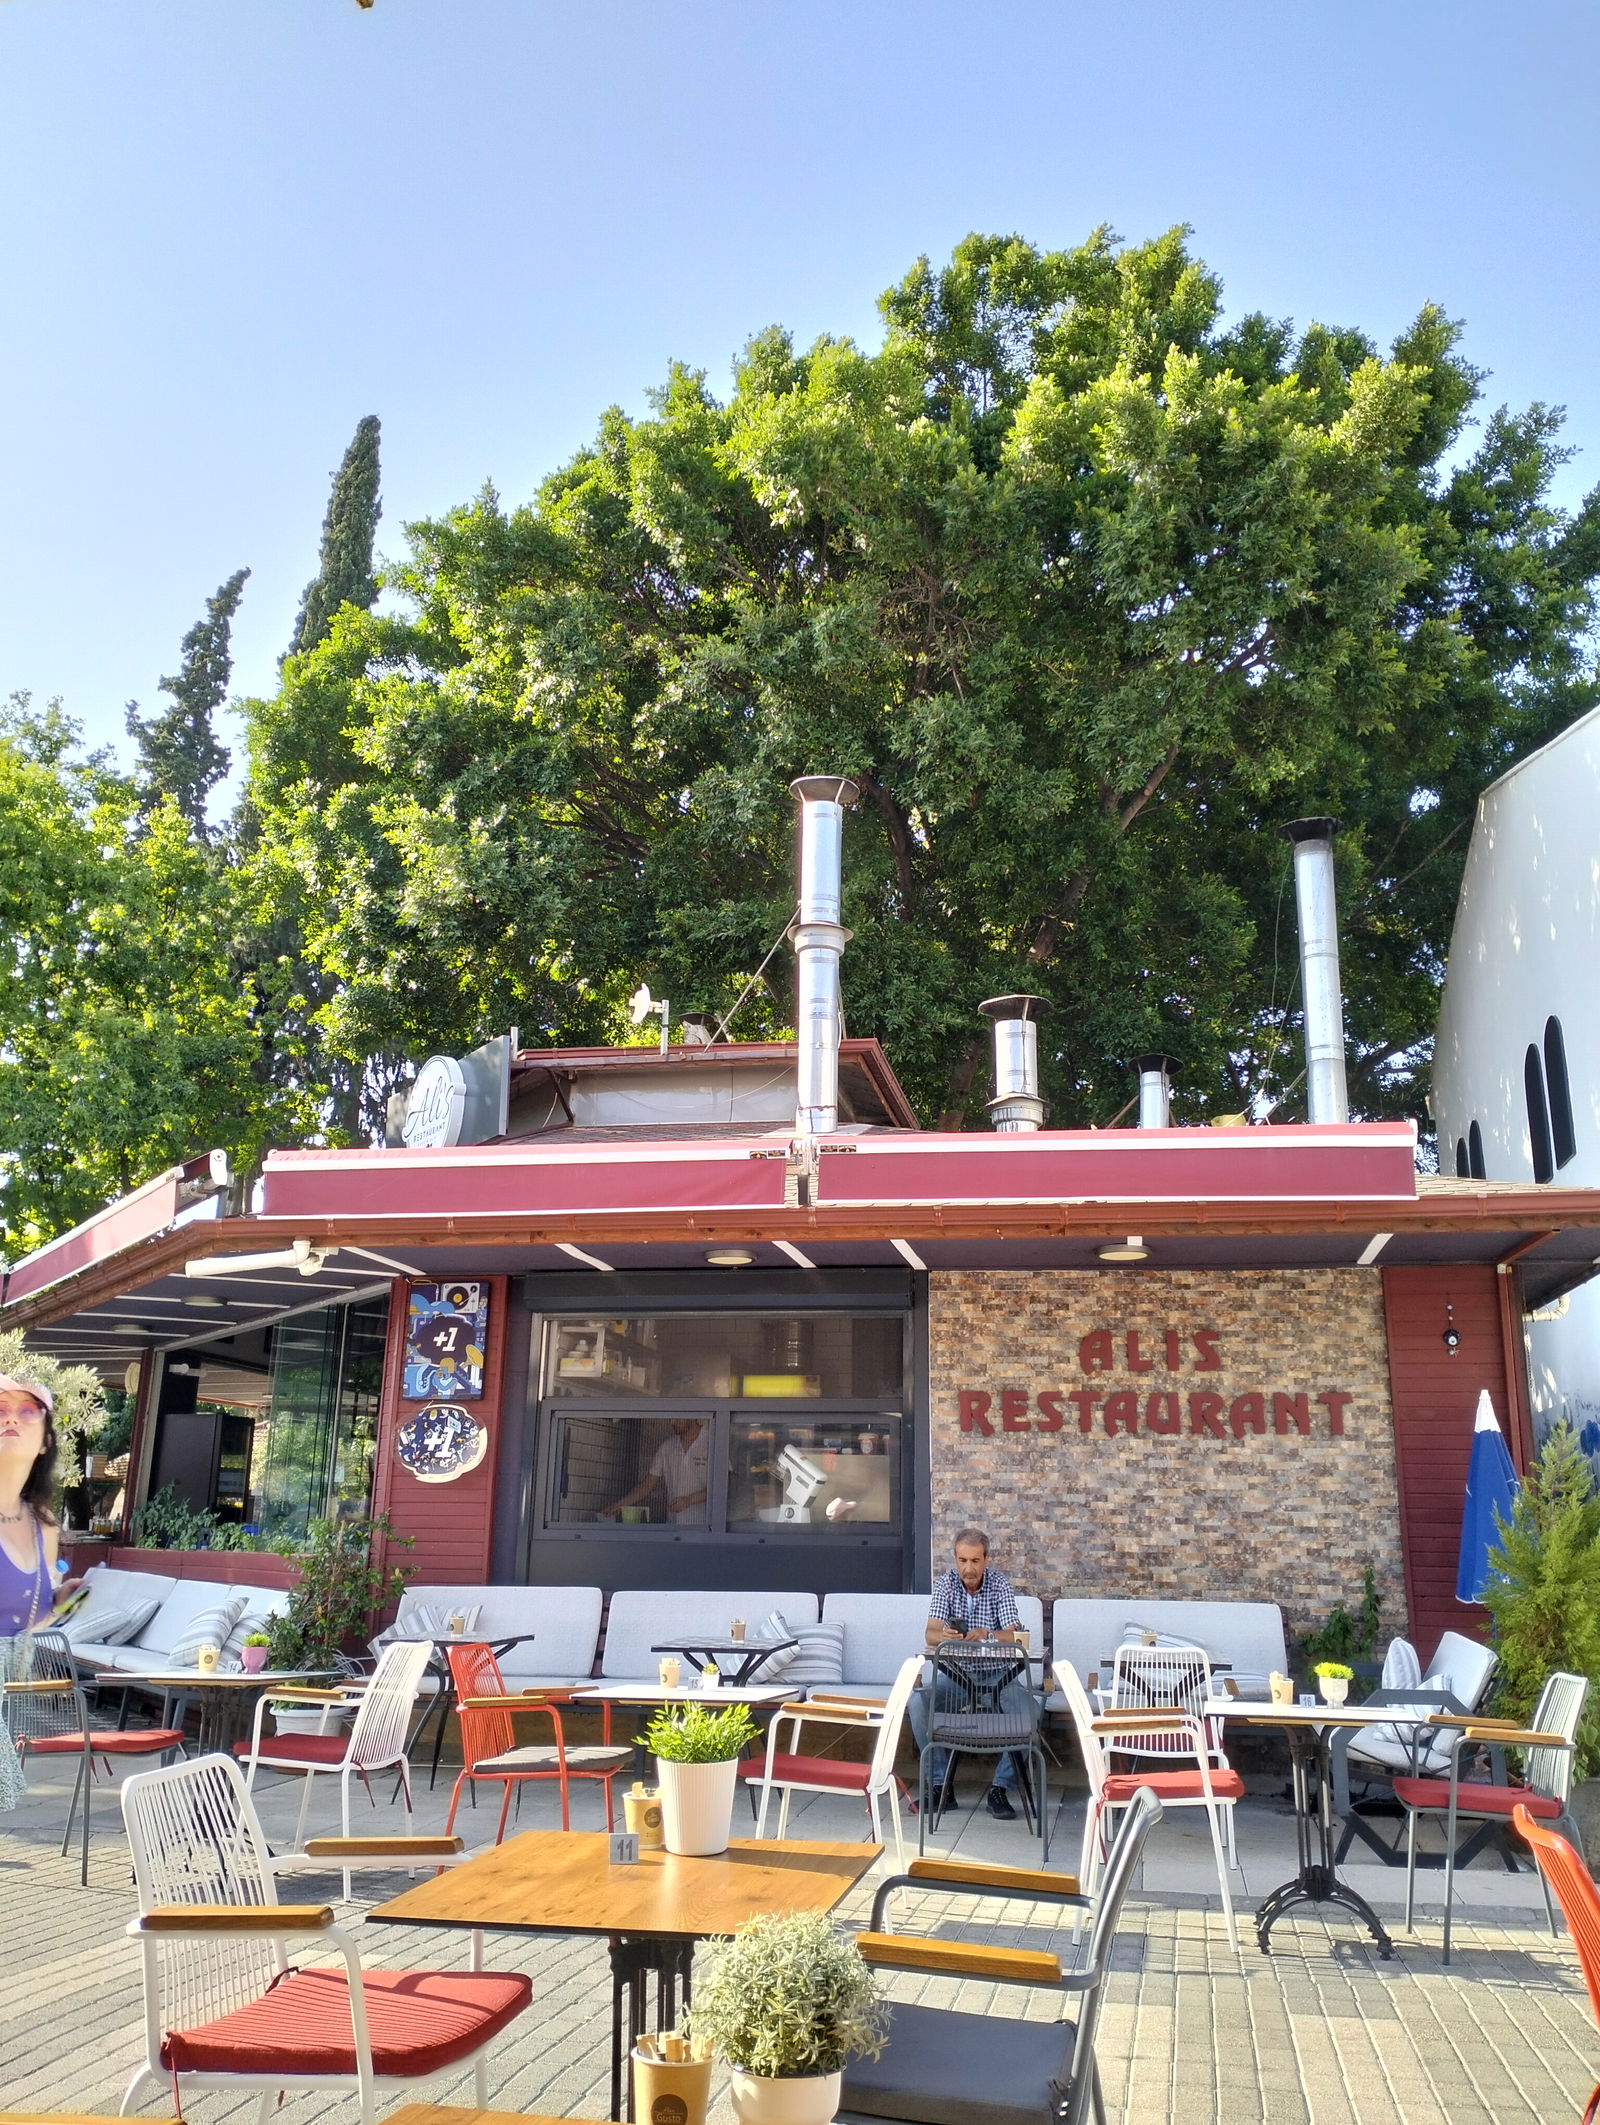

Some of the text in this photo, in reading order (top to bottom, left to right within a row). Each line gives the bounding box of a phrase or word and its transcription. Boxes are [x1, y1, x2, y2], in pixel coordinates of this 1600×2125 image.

[413, 1121, 447, 1143] RESTAURANT
[433, 1327, 458, 1352] +1
[1079, 1329, 1222, 1376] ALIS
[958, 1390, 1354, 1440] RESTAURANT
[423, 1426, 455, 1458] +1
[617, 1839, 633, 1862] 11
